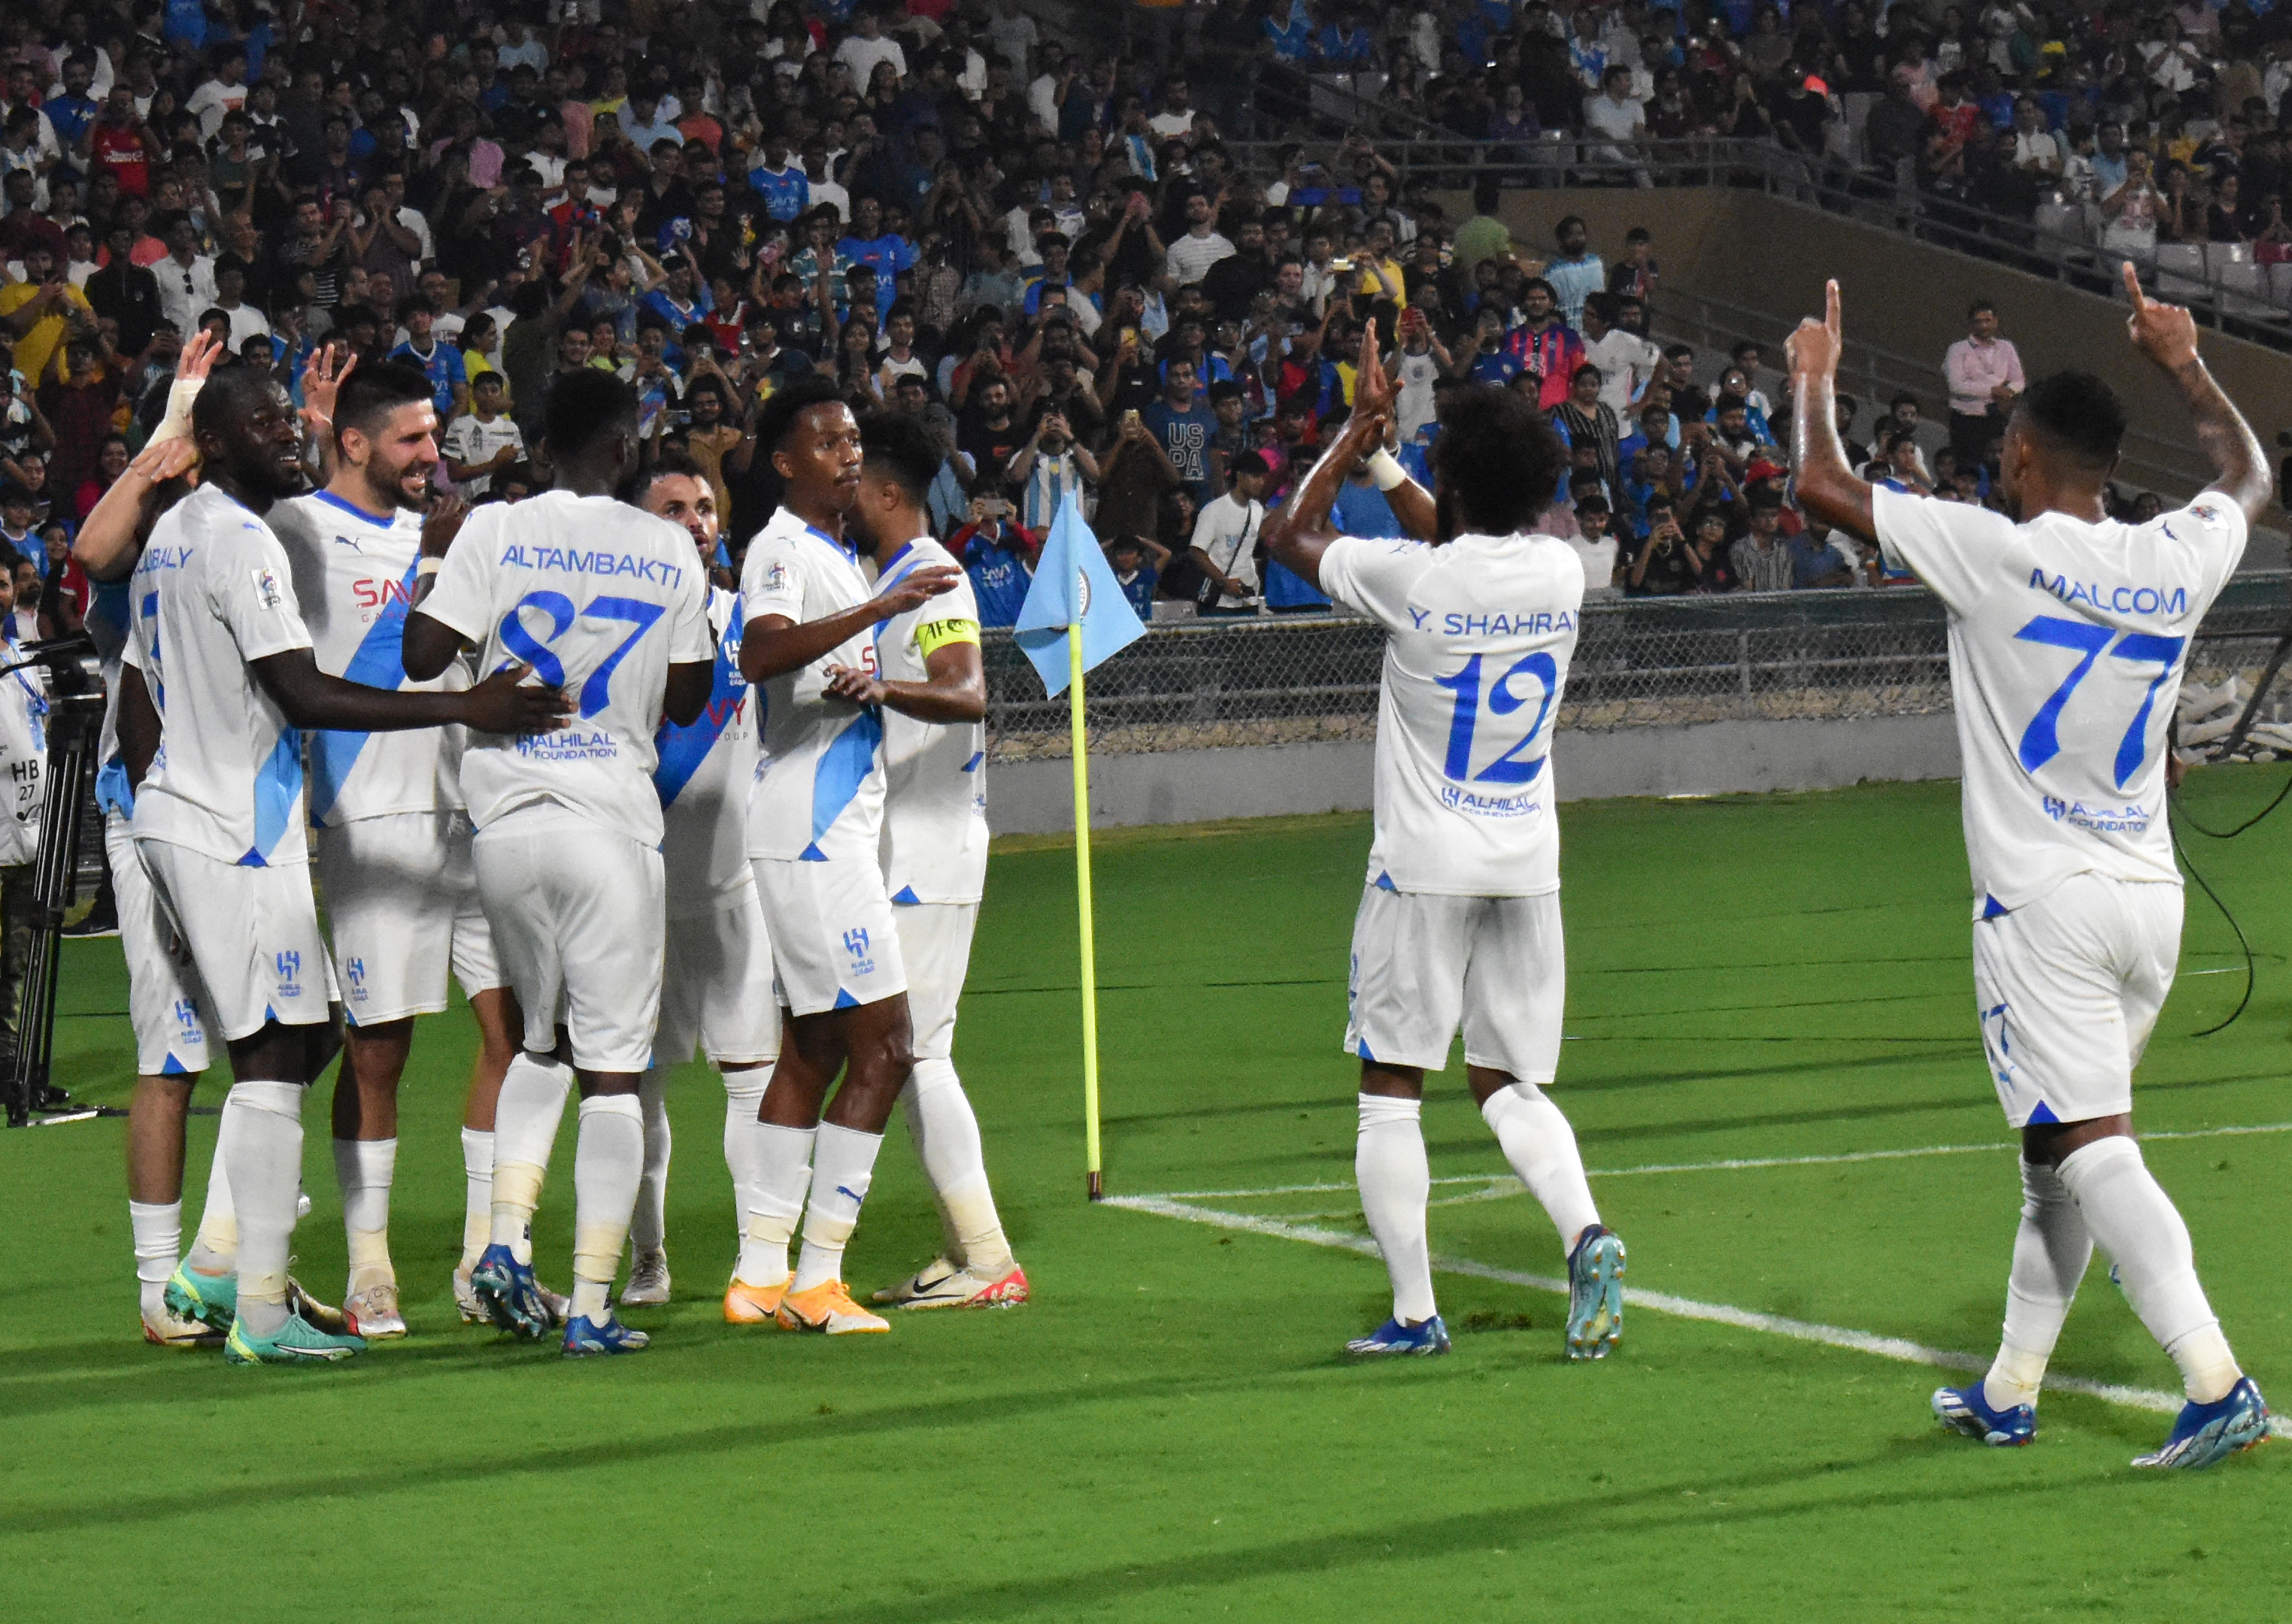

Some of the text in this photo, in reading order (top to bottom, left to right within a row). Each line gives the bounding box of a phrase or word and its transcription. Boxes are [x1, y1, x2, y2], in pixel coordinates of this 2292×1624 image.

[1168, 423, 1204, 449] US
[1168, 449, 1204, 477] PA
[499, 545, 682, 589] ALTAMBAKTI
[2029, 568, 2186, 615] MALCOM
[1408, 607, 1432, 633] Y.
[499, 589, 667, 721] 87
[2012, 614, 2186, 791] 77
[1432, 651, 1557, 784] 12
[534, 748, 617, 760] FOUNDATION
[11, 759, 40, 783] HB
[19, 783, 35, 801] 27
